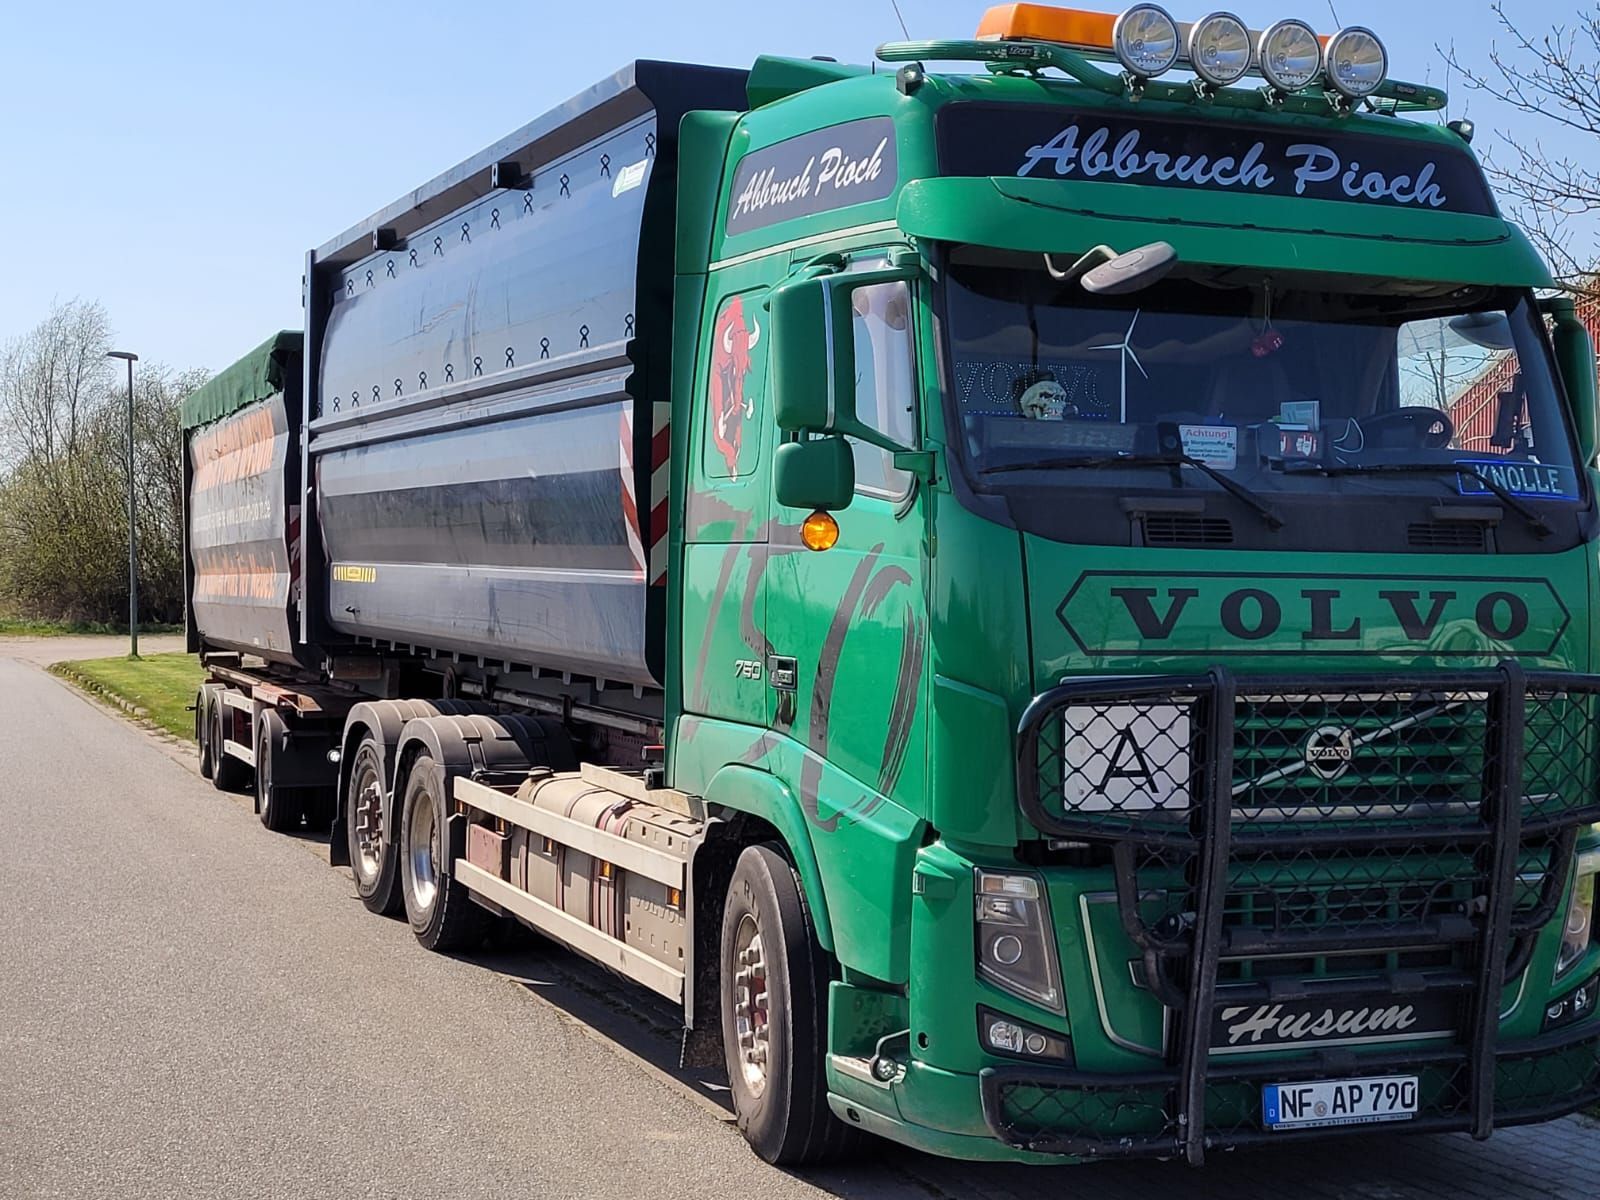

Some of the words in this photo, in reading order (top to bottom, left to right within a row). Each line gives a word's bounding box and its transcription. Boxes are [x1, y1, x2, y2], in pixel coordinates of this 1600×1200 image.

[733, 156, 815, 220] Abbruch
[815, 137, 888, 197] Pioch
[1017, 124, 1275, 189] Abbruch
[1285, 143, 1447, 208] Pioch
[1186, 428, 1231, 439] Achtung!
[1110, 587, 1529, 641] VOLVO
[1096, 723, 1160, 795] A
[1310, 749, 1350, 757] VOLVO
[1221, 1004, 1417, 1044] Husum
[1281, 1088, 1314, 1118] NF
[1332, 1085, 1363, 1114] AP
[1370, 1081, 1416, 1111] 790
